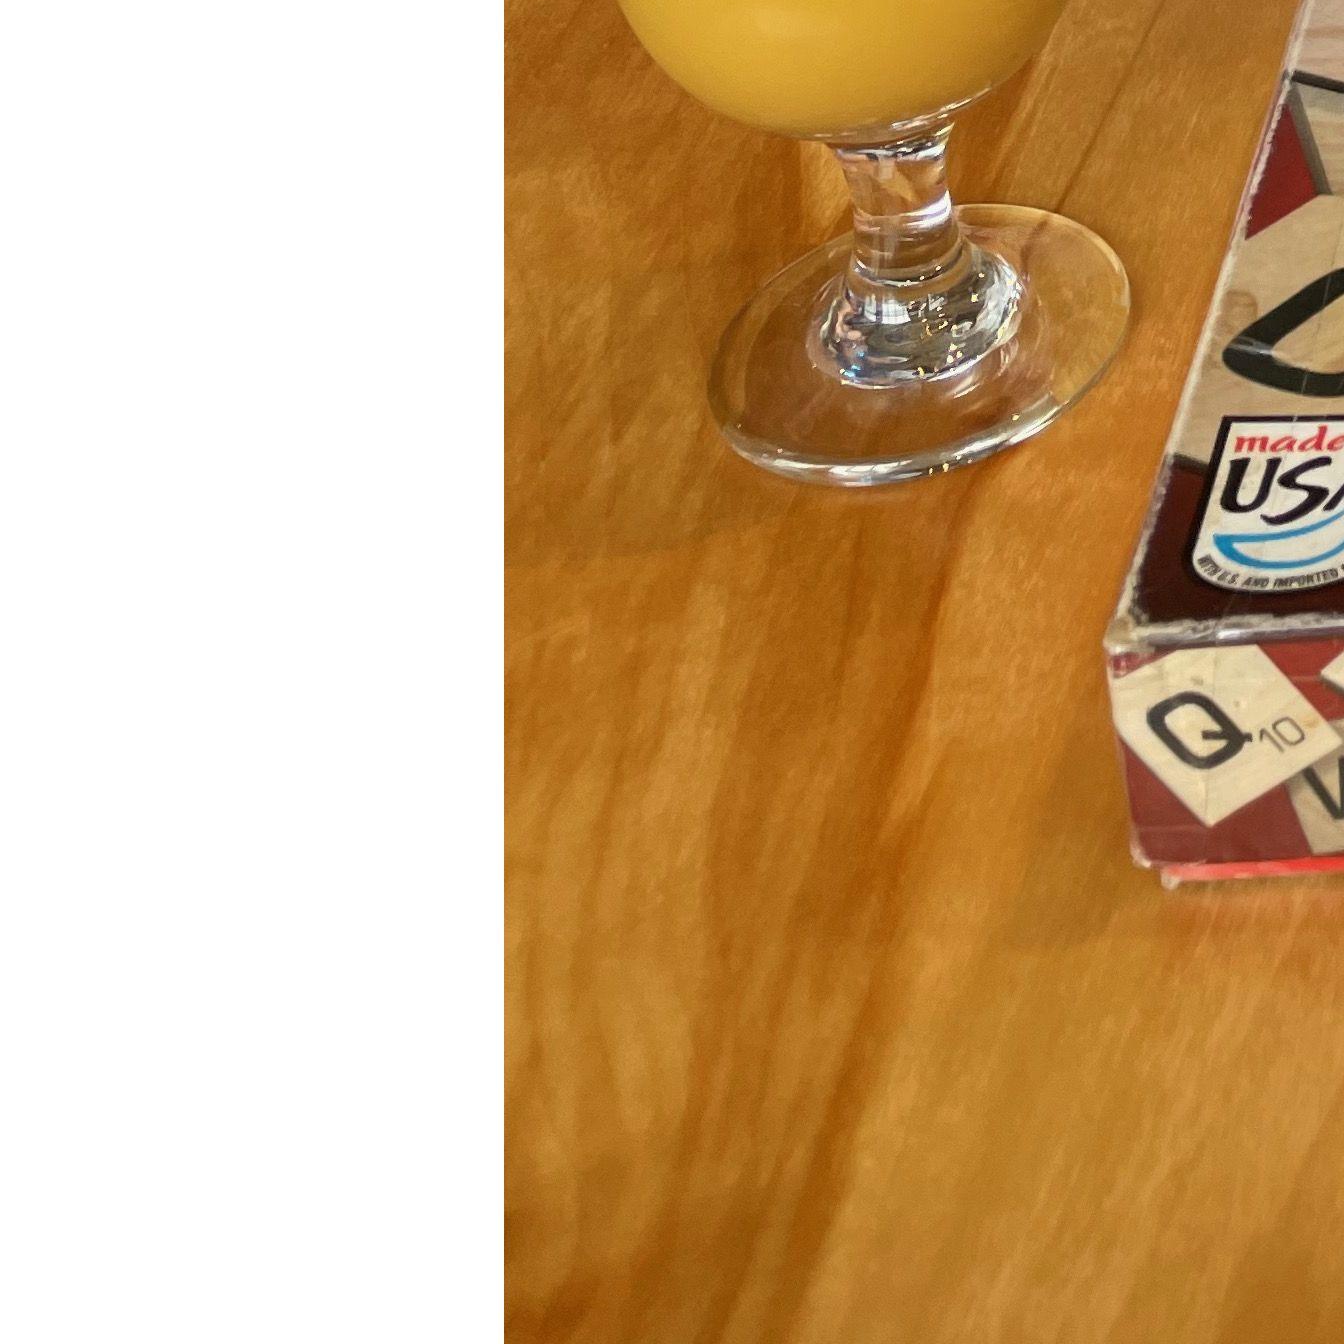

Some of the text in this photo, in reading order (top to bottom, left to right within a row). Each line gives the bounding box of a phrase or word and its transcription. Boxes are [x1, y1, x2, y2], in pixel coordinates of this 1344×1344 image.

[1243, 575, 1270, 588] AND
[1146, 690, 1307, 769] Q 10
